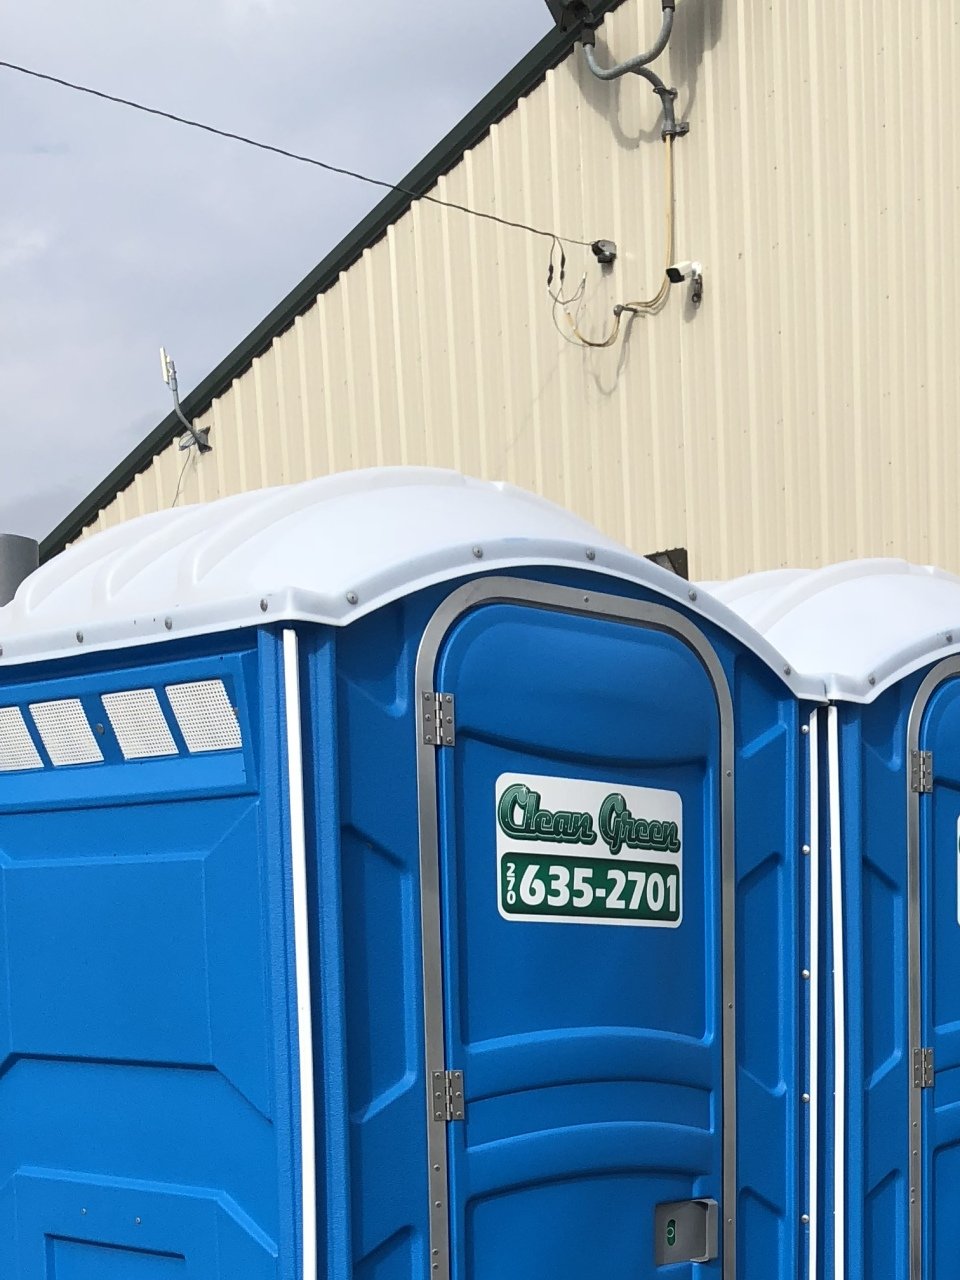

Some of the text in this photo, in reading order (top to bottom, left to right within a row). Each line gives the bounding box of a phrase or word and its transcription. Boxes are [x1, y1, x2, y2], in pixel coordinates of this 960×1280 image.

[498, 783, 681, 855] Clean Green
[519, 864, 677, 912] 635-2701
